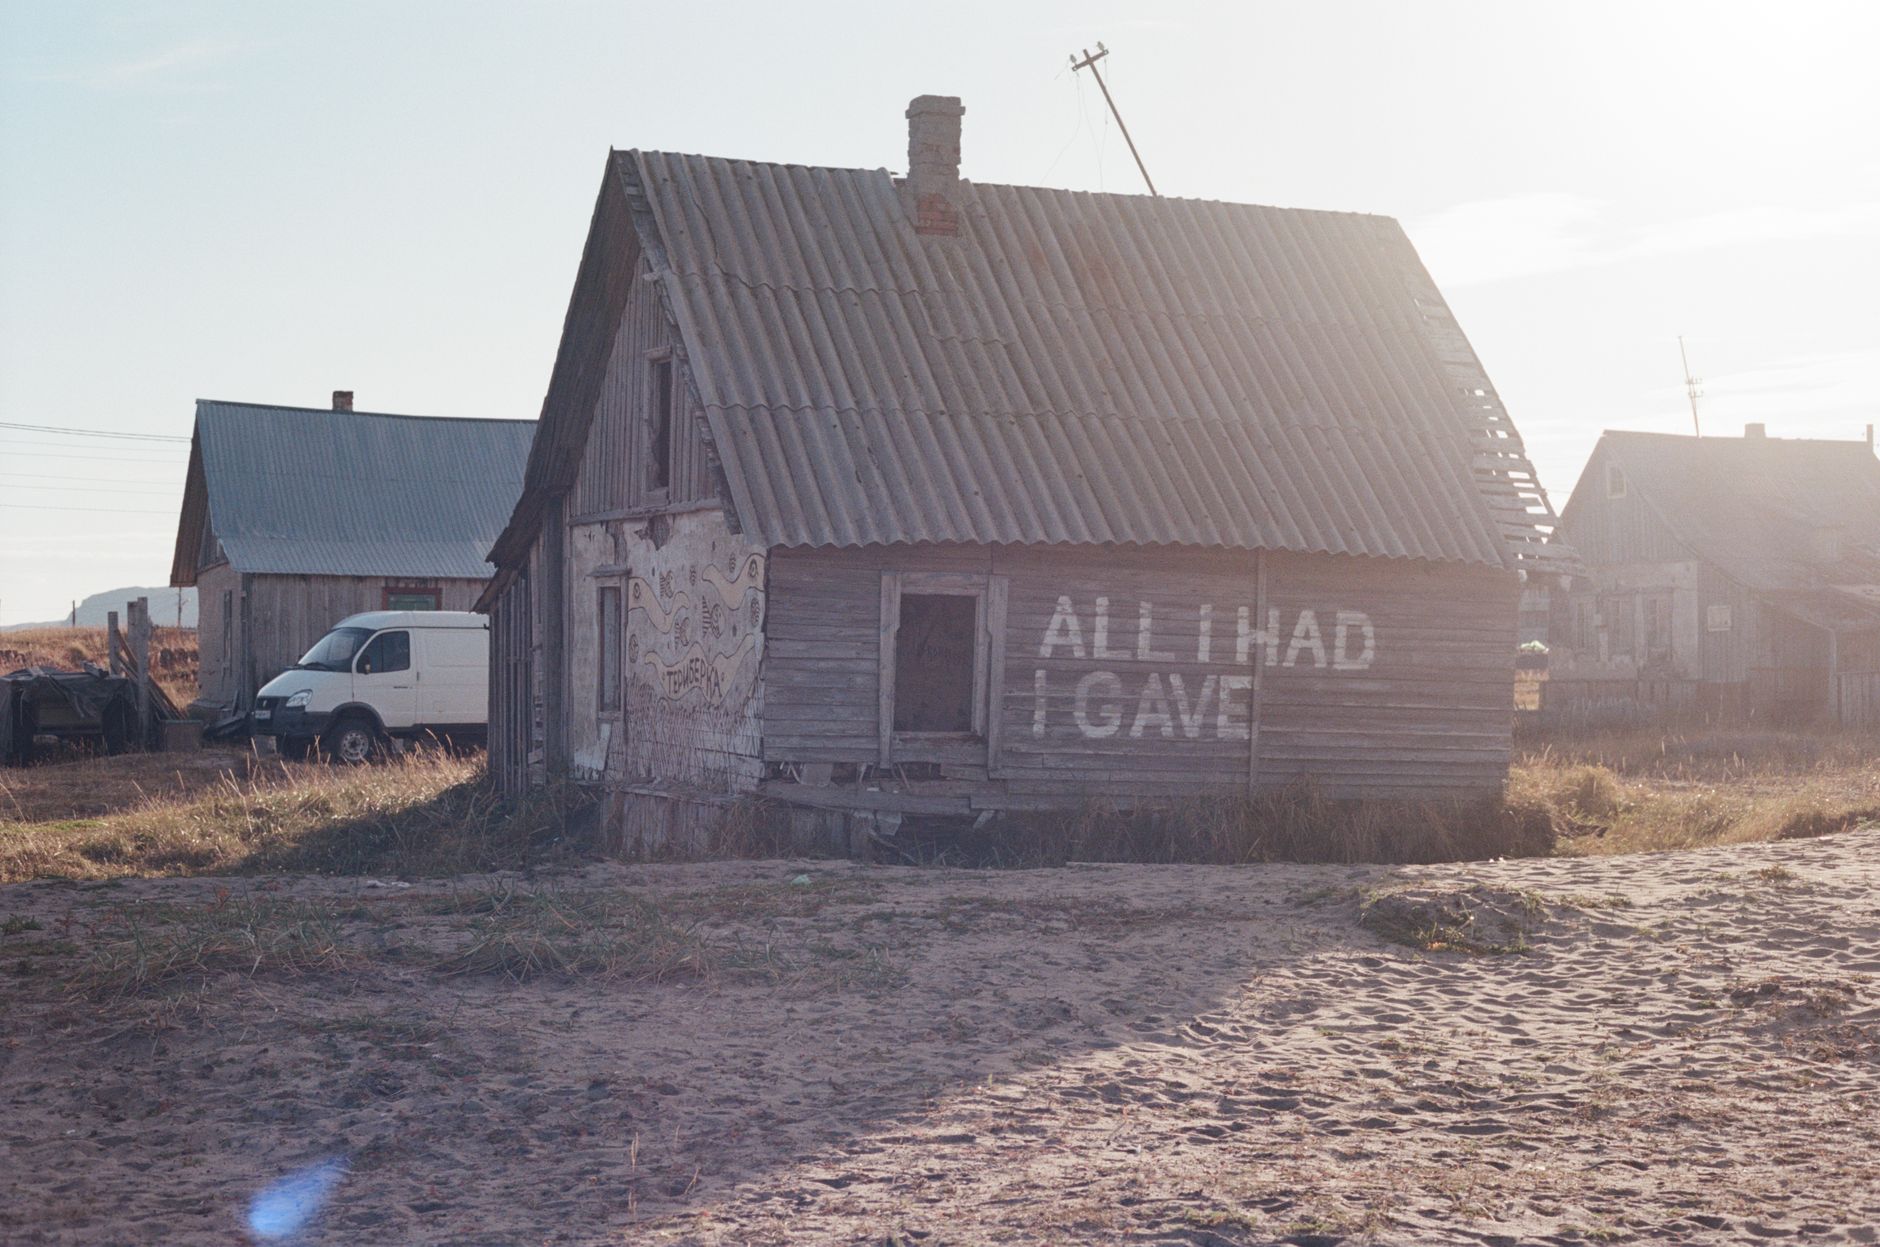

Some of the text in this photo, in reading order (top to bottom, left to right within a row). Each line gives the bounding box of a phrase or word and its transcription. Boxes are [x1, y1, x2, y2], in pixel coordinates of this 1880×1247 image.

[1039, 595, 1375, 669] ALL I HAD
[666, 657, 722, 699] ТЕРИБЕРКА
[1032, 669, 1253, 739] I GAVE
